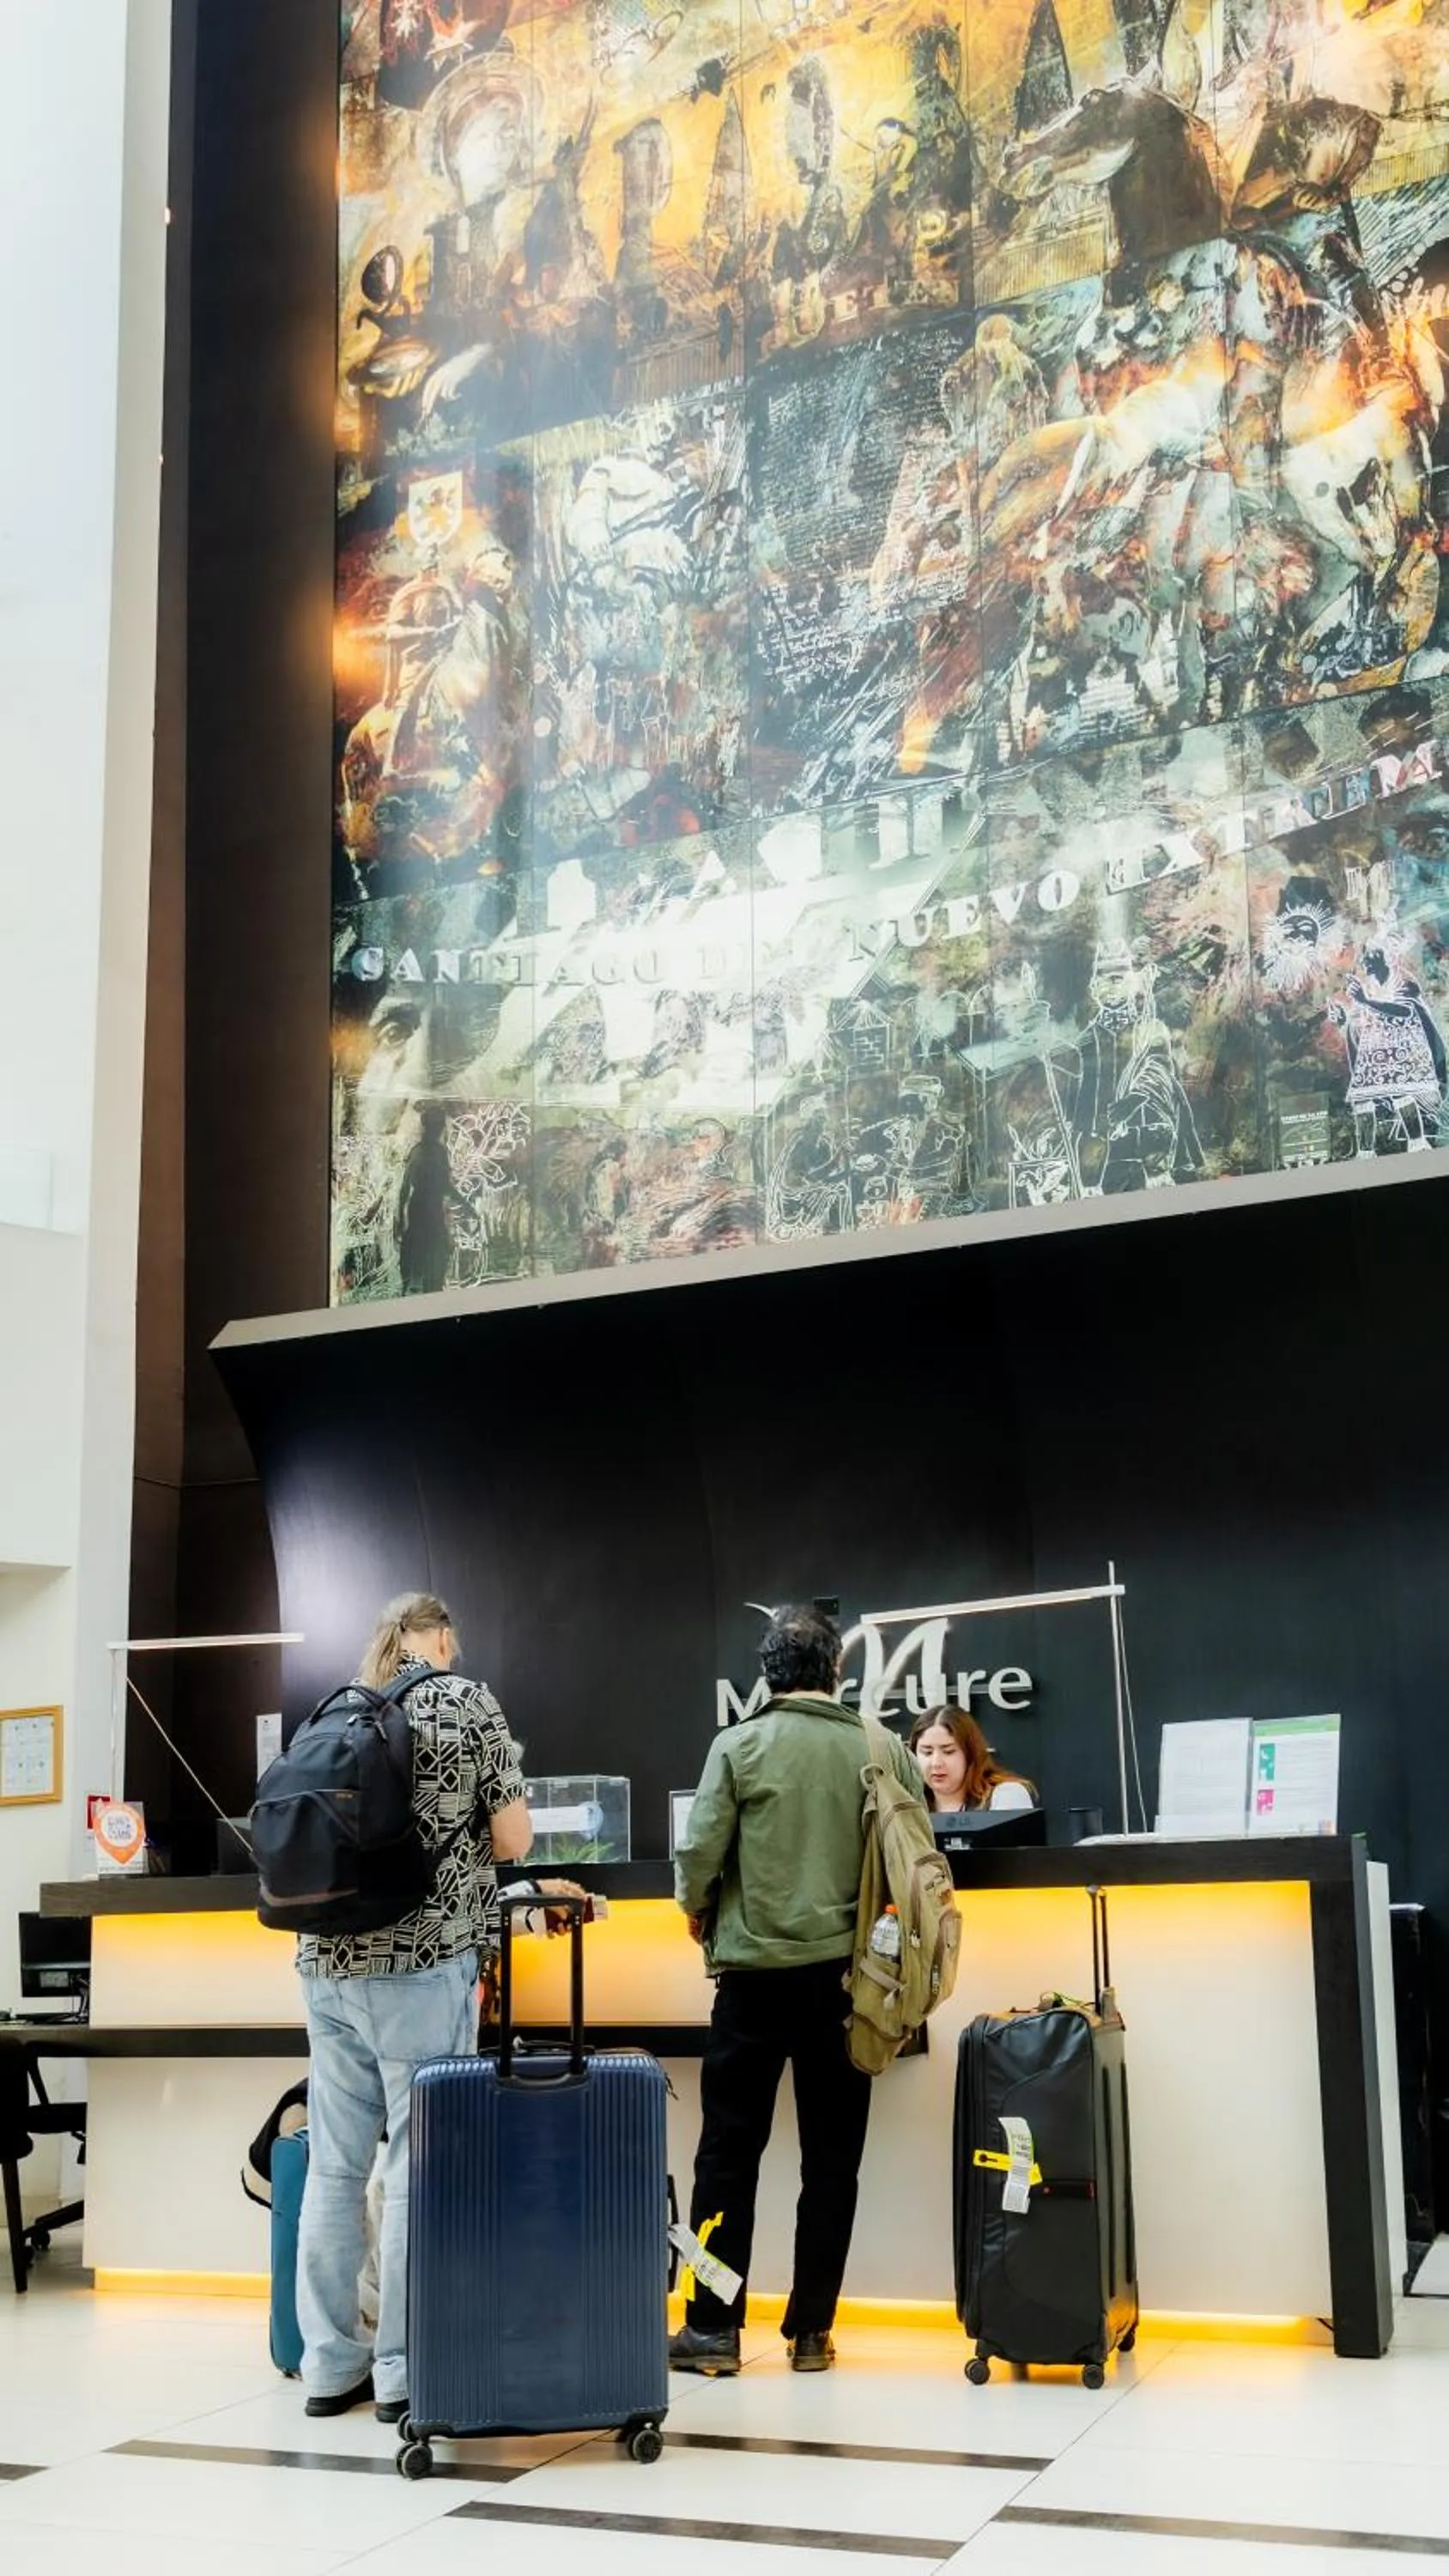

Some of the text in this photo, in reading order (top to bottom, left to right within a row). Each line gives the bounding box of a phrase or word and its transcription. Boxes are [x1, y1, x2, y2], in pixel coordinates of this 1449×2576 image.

[350, 944, 665, 986] SANTIAGO
[840, 869, 1081, 963] NUEVO
[715, 1666, 1034, 1728] Mrcure
